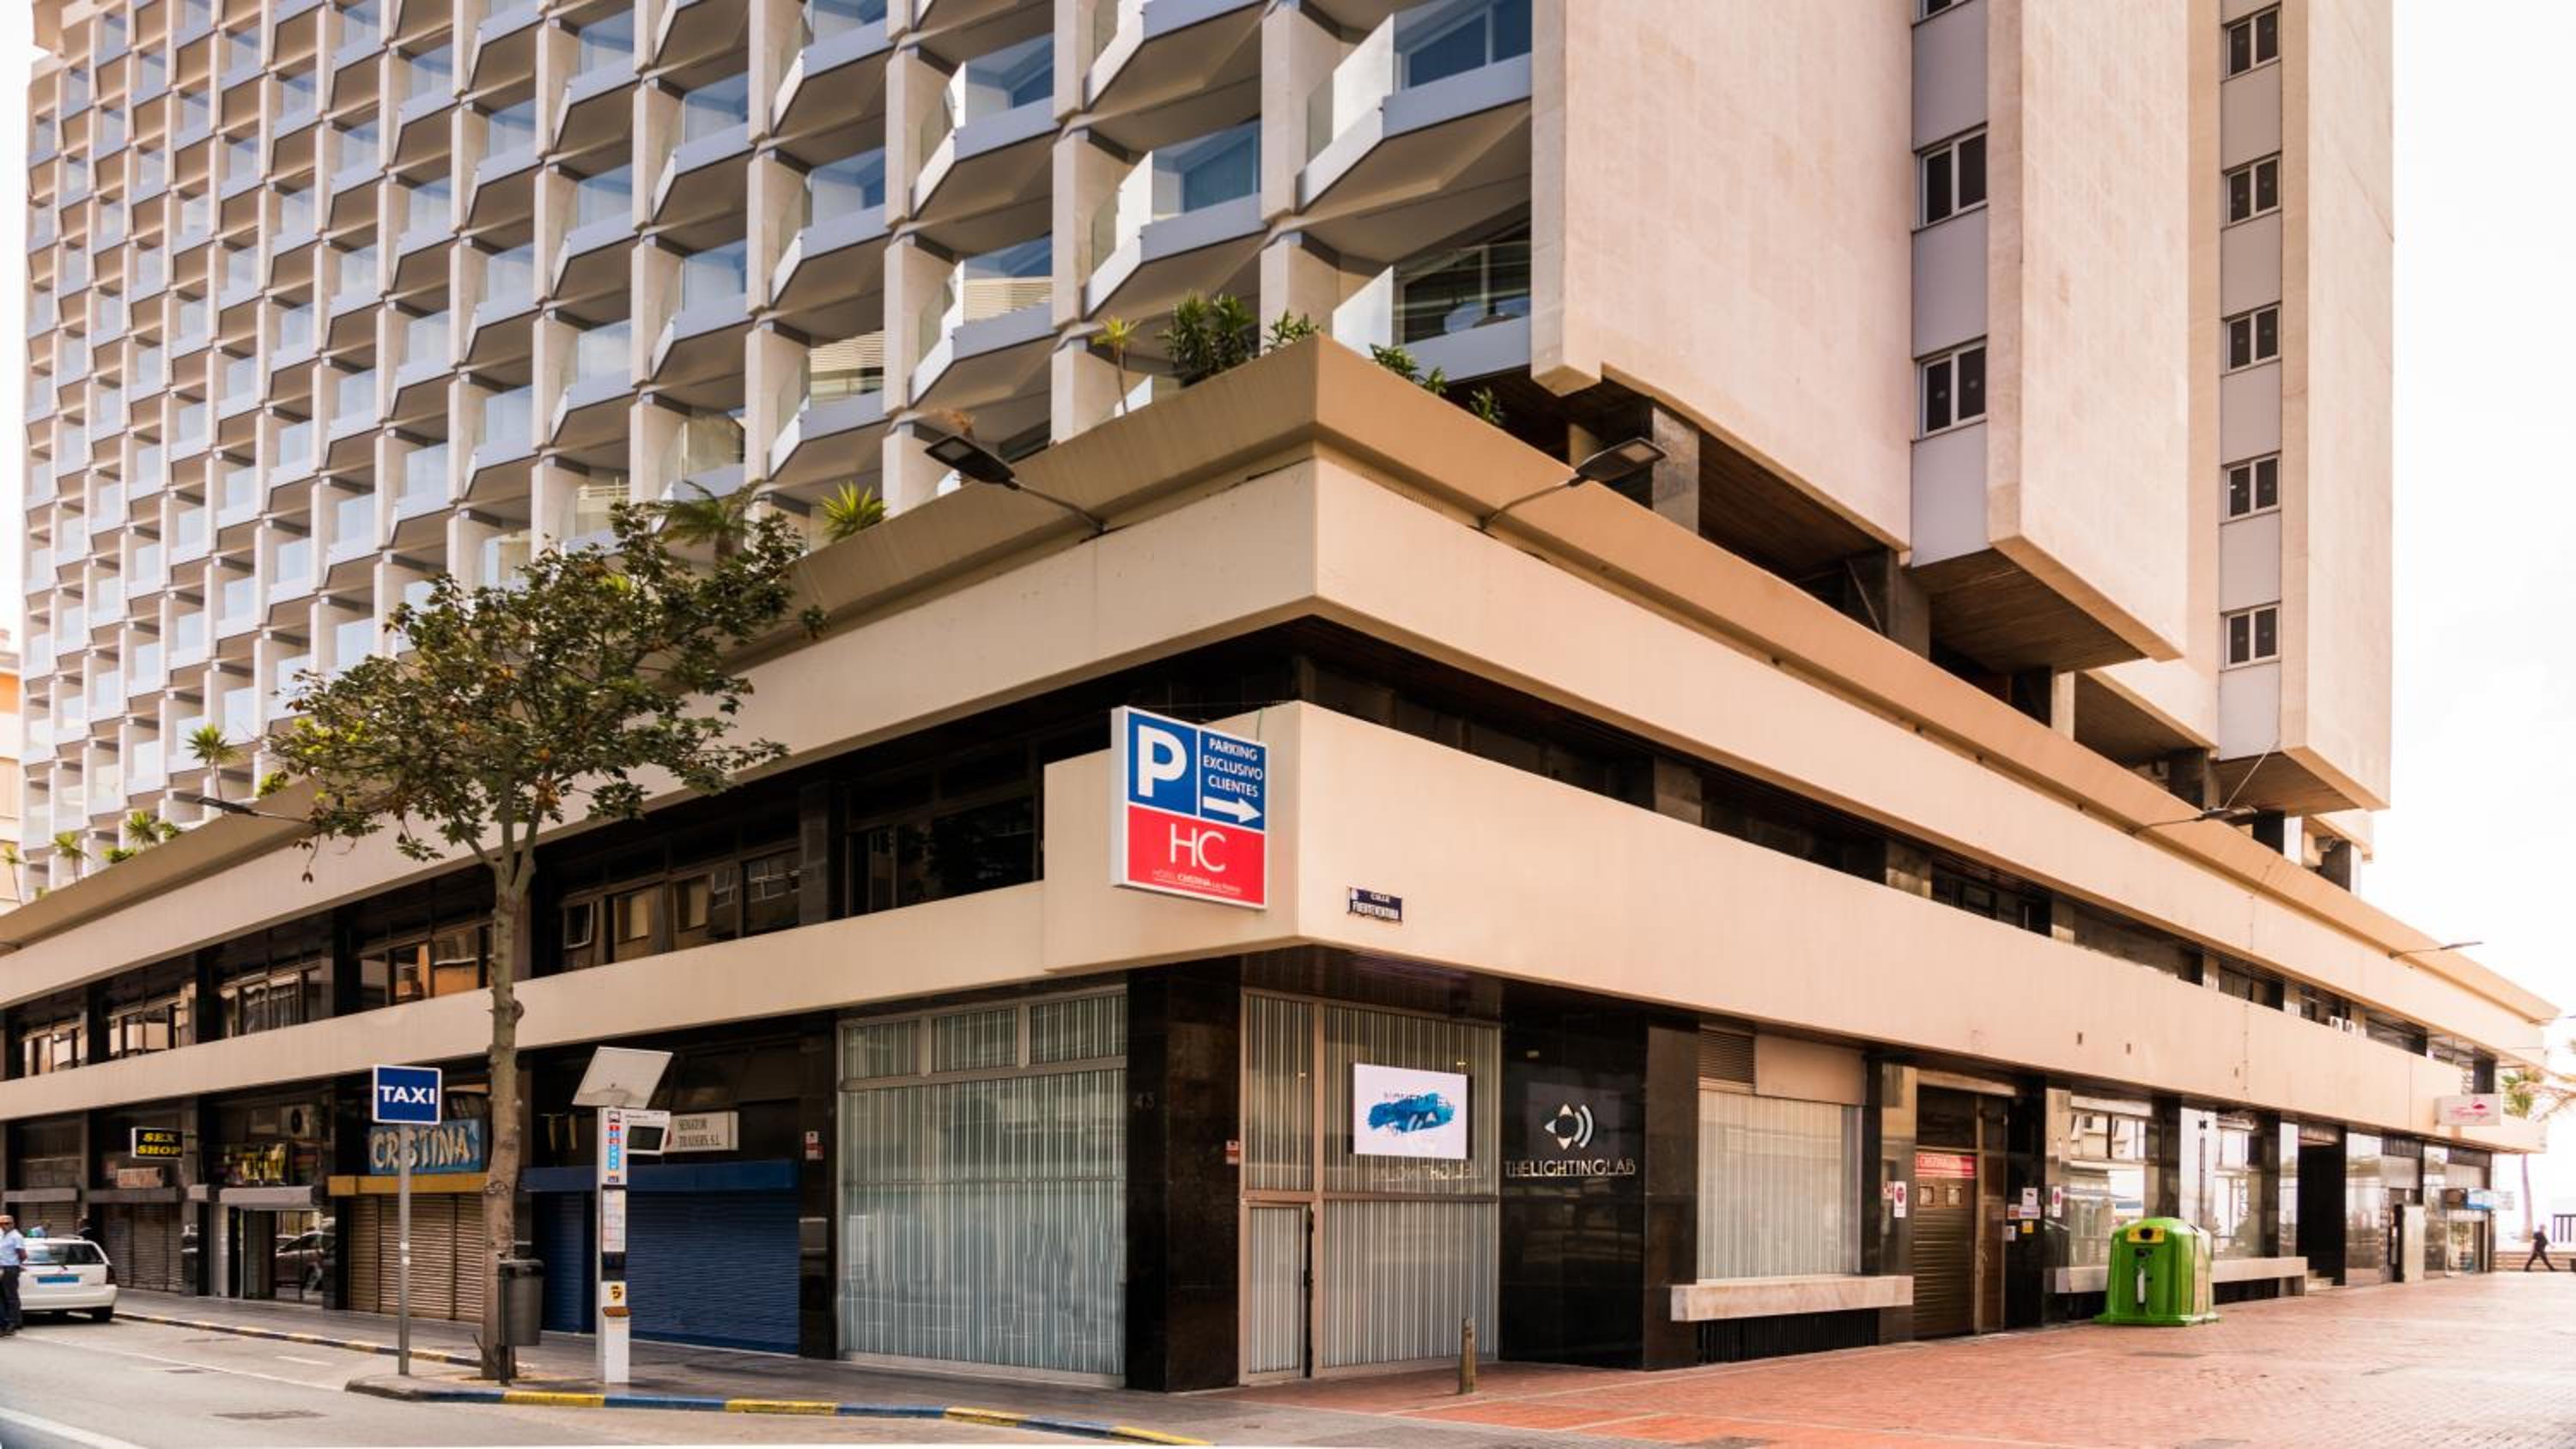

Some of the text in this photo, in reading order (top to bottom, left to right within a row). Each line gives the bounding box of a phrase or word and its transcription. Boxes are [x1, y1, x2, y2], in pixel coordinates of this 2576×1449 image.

[1138, 724, 1188, 797] P
[1209, 737, 1258, 761] PARKING
[1203, 755, 1263, 779] EXCLUSIVO
[1208, 775, 1258, 797] CLIENTES
[1170, 823, 1226, 872] HC
[379, 1085, 435, 1104] TAXI
[142, 1132, 177, 1143] SEX
[373, 1126, 471, 1167] CRSTINA
[137, 1145, 181, 1155] SHOP
